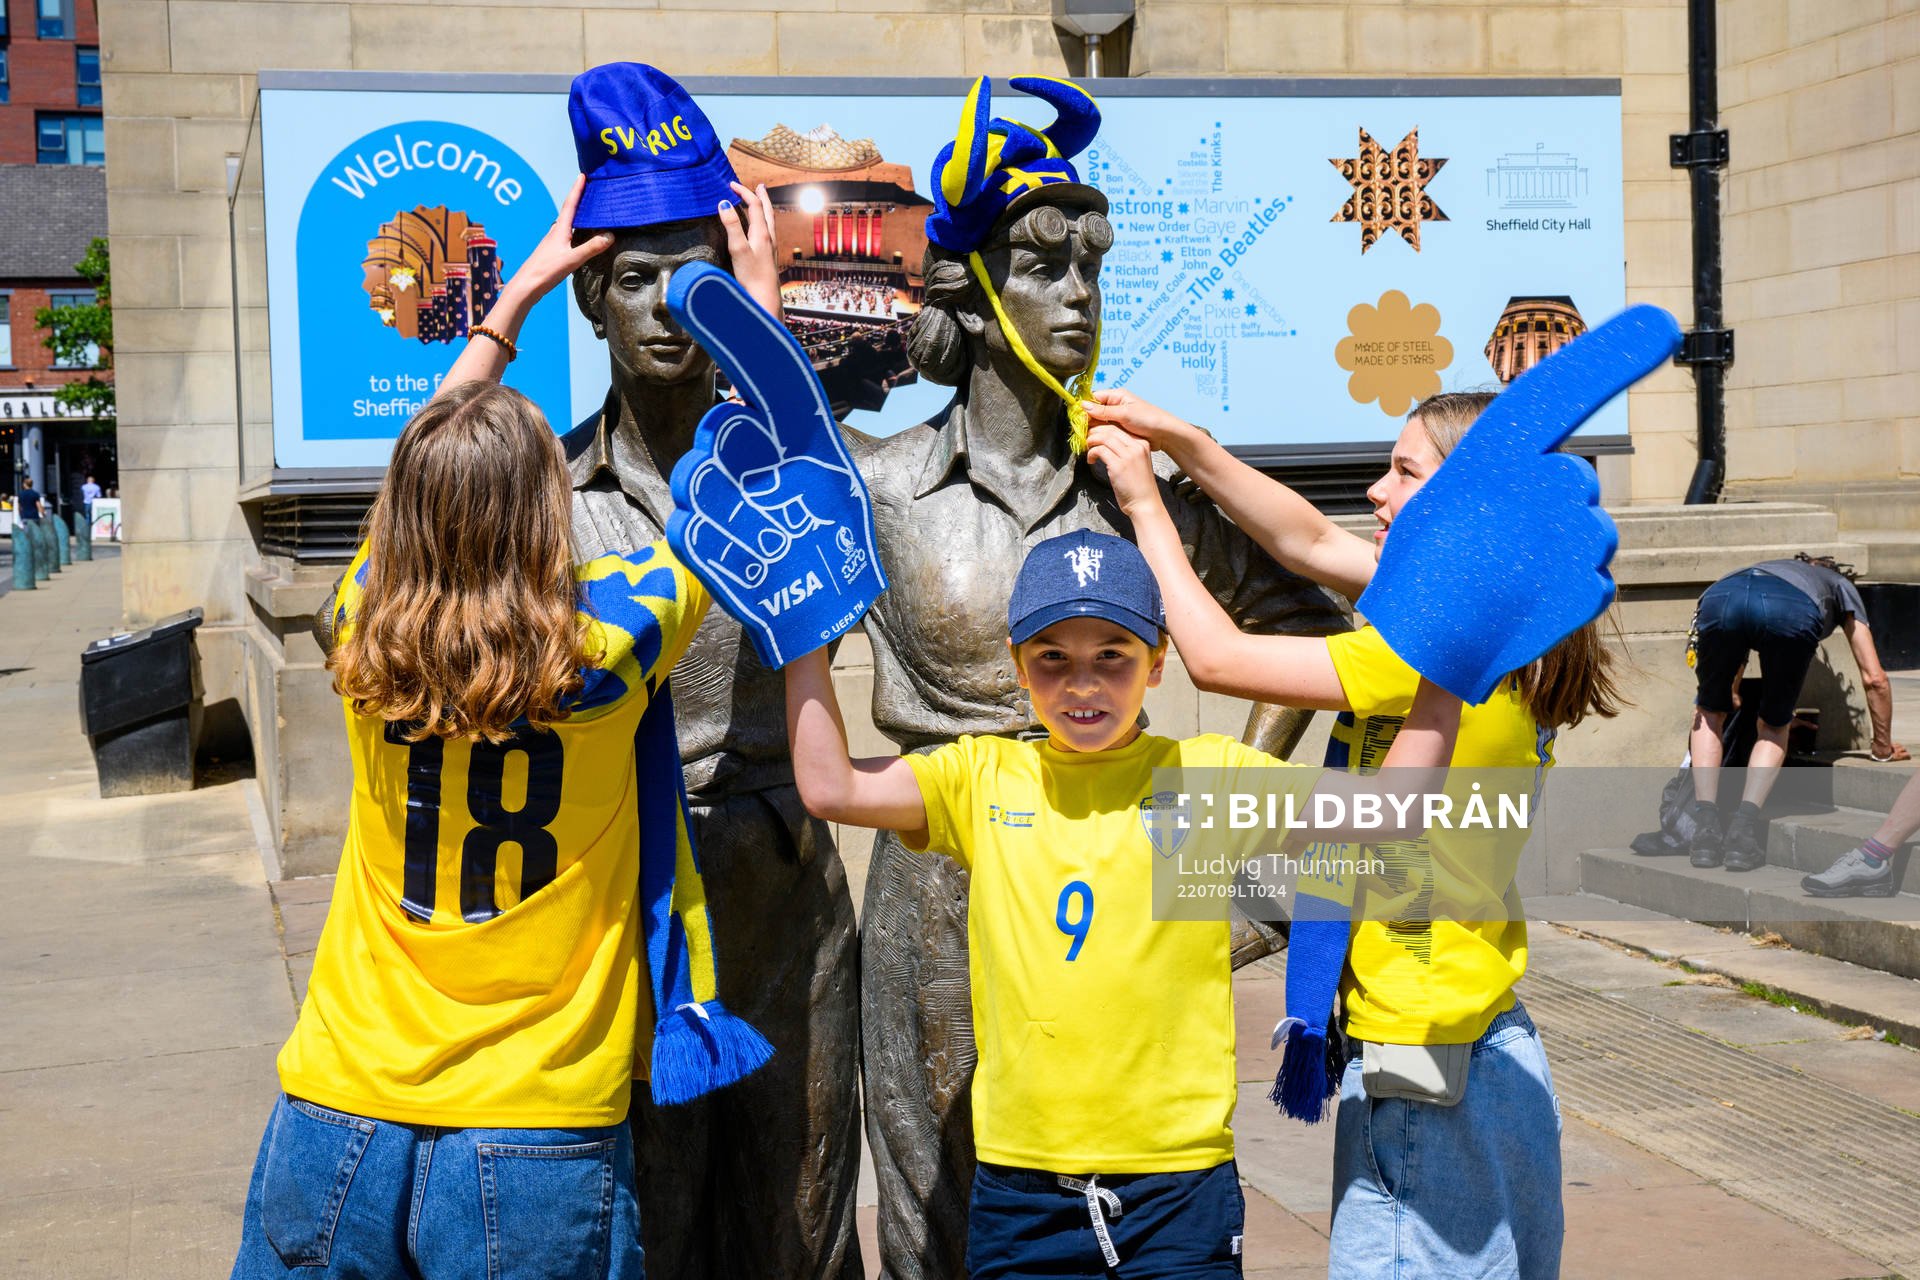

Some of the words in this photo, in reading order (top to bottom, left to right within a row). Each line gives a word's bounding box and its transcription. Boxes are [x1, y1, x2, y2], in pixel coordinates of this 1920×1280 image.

[600, 115, 693, 156] SVRIG
[1212, 131, 1222, 167] Kinks
[331, 134, 522, 206] Welcome
[1106, 174, 1123, 183] Bon
[1212, 170, 1222, 193] The
[1106, 186, 1124, 195] Jovi
[1193, 198, 1249, 213] Marvin
[1129, 222, 1155, 232] New
[1158, 221, 1191, 232] Order
[1194, 218, 1236, 238] Gaye
[1486, 218, 1539, 231] Sheffield
[1541, 218, 1566, 233] City
[1568, 218, 1591, 230] Hall
[1165, 235, 1212, 244] Kraftwerk
[1118, 249, 1152, 262] Black
[1181, 246, 1212, 257] Elton
[1186, 266, 1224, 300] The
[1219, 196, 1286, 267] Beatles
[1115, 265, 1159, 275] Richard
[1181, 260, 1208, 270] John
[1116, 278, 1159, 291] Hawley
[1105, 293, 1131, 305] Hot
[1131, 313, 1150, 331] Nat
[1147, 291, 1170, 314] King
[1165, 272, 1186, 293] Cole
[1102, 308, 1132, 320] late
[1204, 304, 1241, 318] Pixie
[1101, 328, 1128, 344] erry
[1205, 322, 1237, 339] Lott
[1100, 346, 1124, 354] uran
[1112, 367, 1135, 389] nch
[1131, 357, 1144, 368] &
[1139, 305, 1190, 359] Saunders
[1173, 341, 1216, 356] Buddy
[1387, 341, 1400, 352] OF
[1403, 340, 1434, 351] STEEL
[1099, 358, 1124, 366] uran
[1181, 357, 1216, 371] Holly
[1354, 355, 1384, 366] MADE
[1386, 354, 1400, 365] OF
[369, 375, 391, 392] to
[395, 373, 428, 392] the
[756, 570, 824, 617] VISA
[831, 611, 855, 633] UEFA
[384, 719, 564, 925] 18
[1055, 880, 1094, 962] 9
